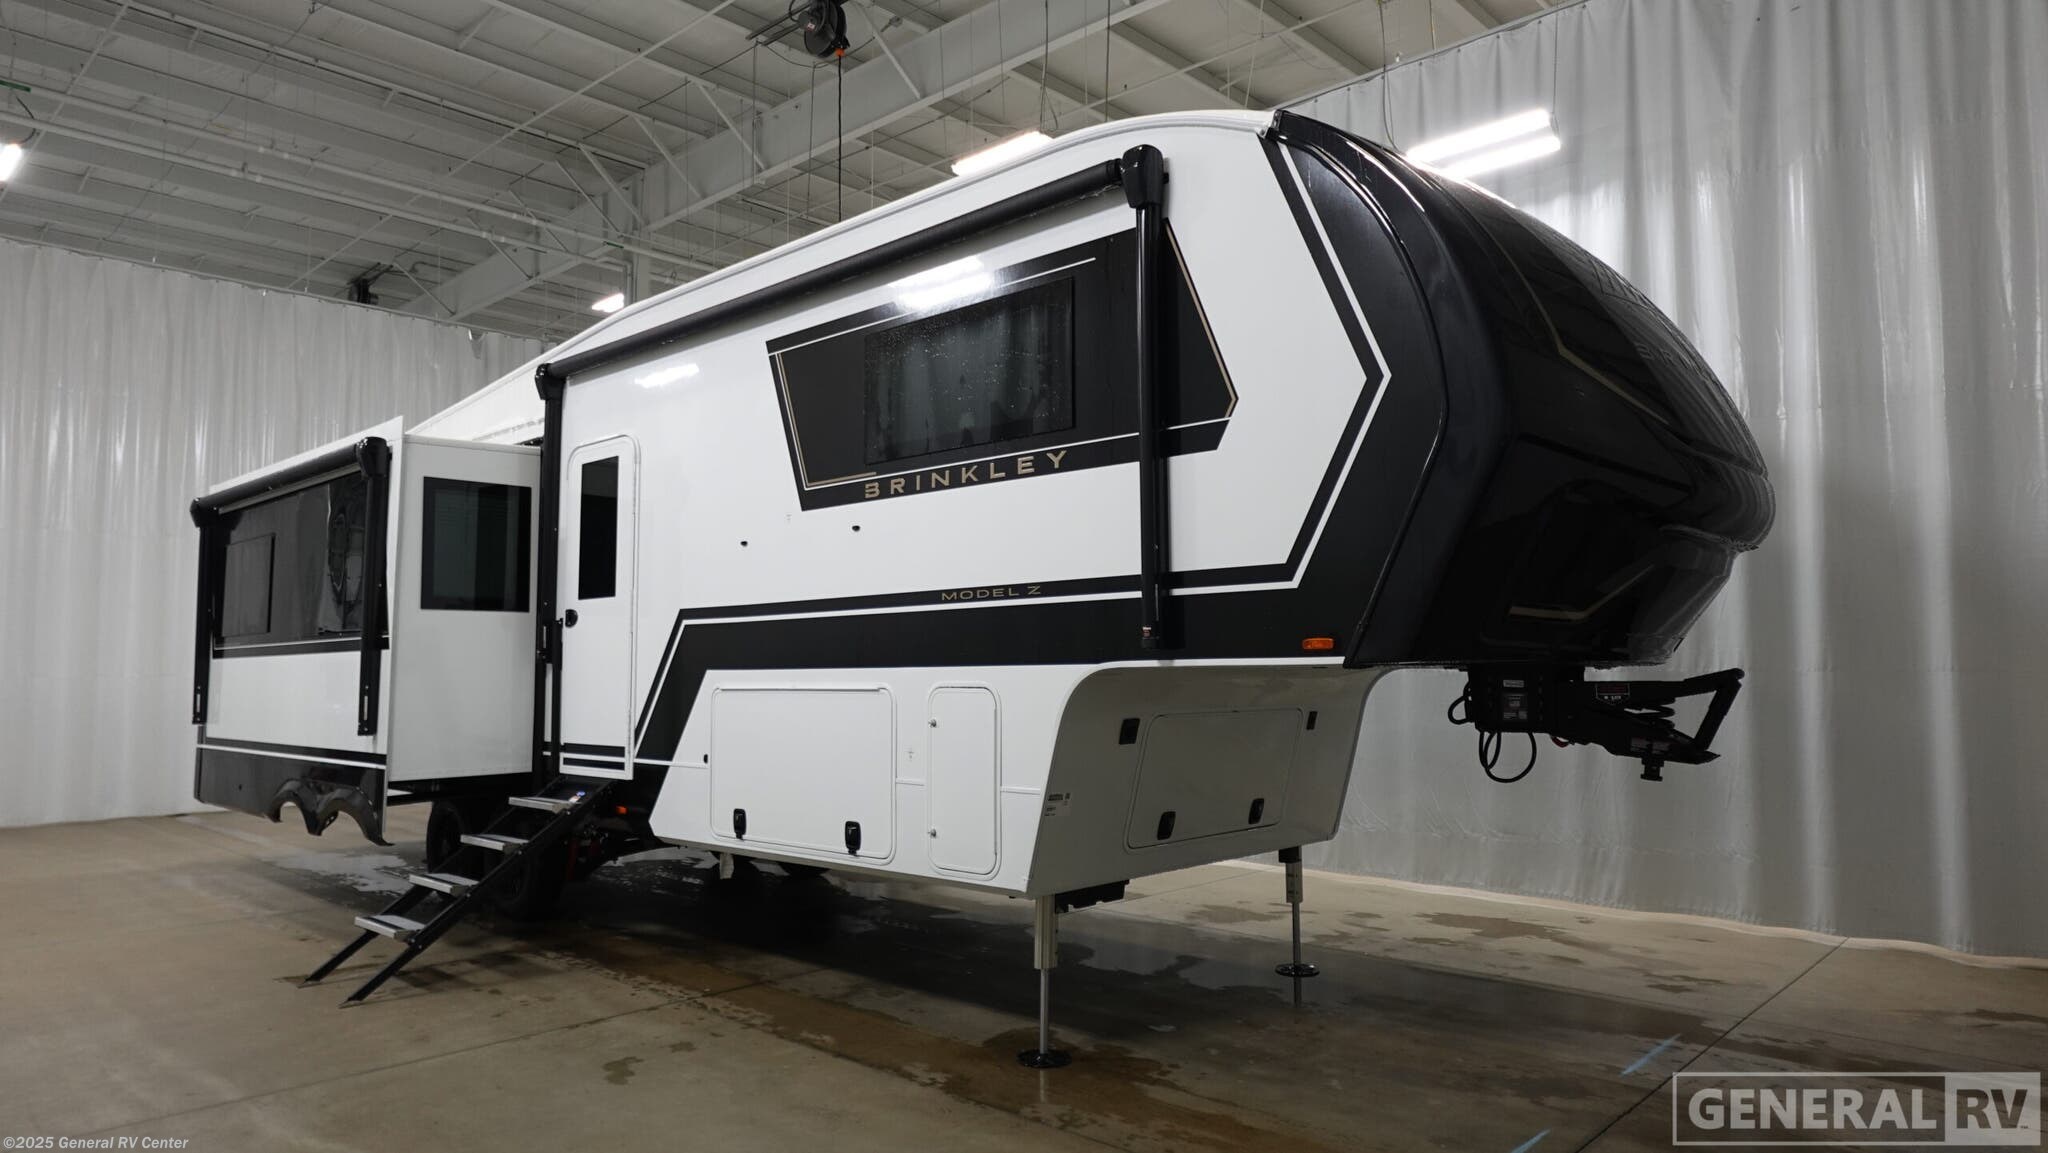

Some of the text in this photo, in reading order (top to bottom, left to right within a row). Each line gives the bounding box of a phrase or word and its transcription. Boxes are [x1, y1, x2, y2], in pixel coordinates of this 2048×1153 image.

[865, 450, 1067, 498] BRINKLEY
[942, 585, 1041, 600] MODEL Z
